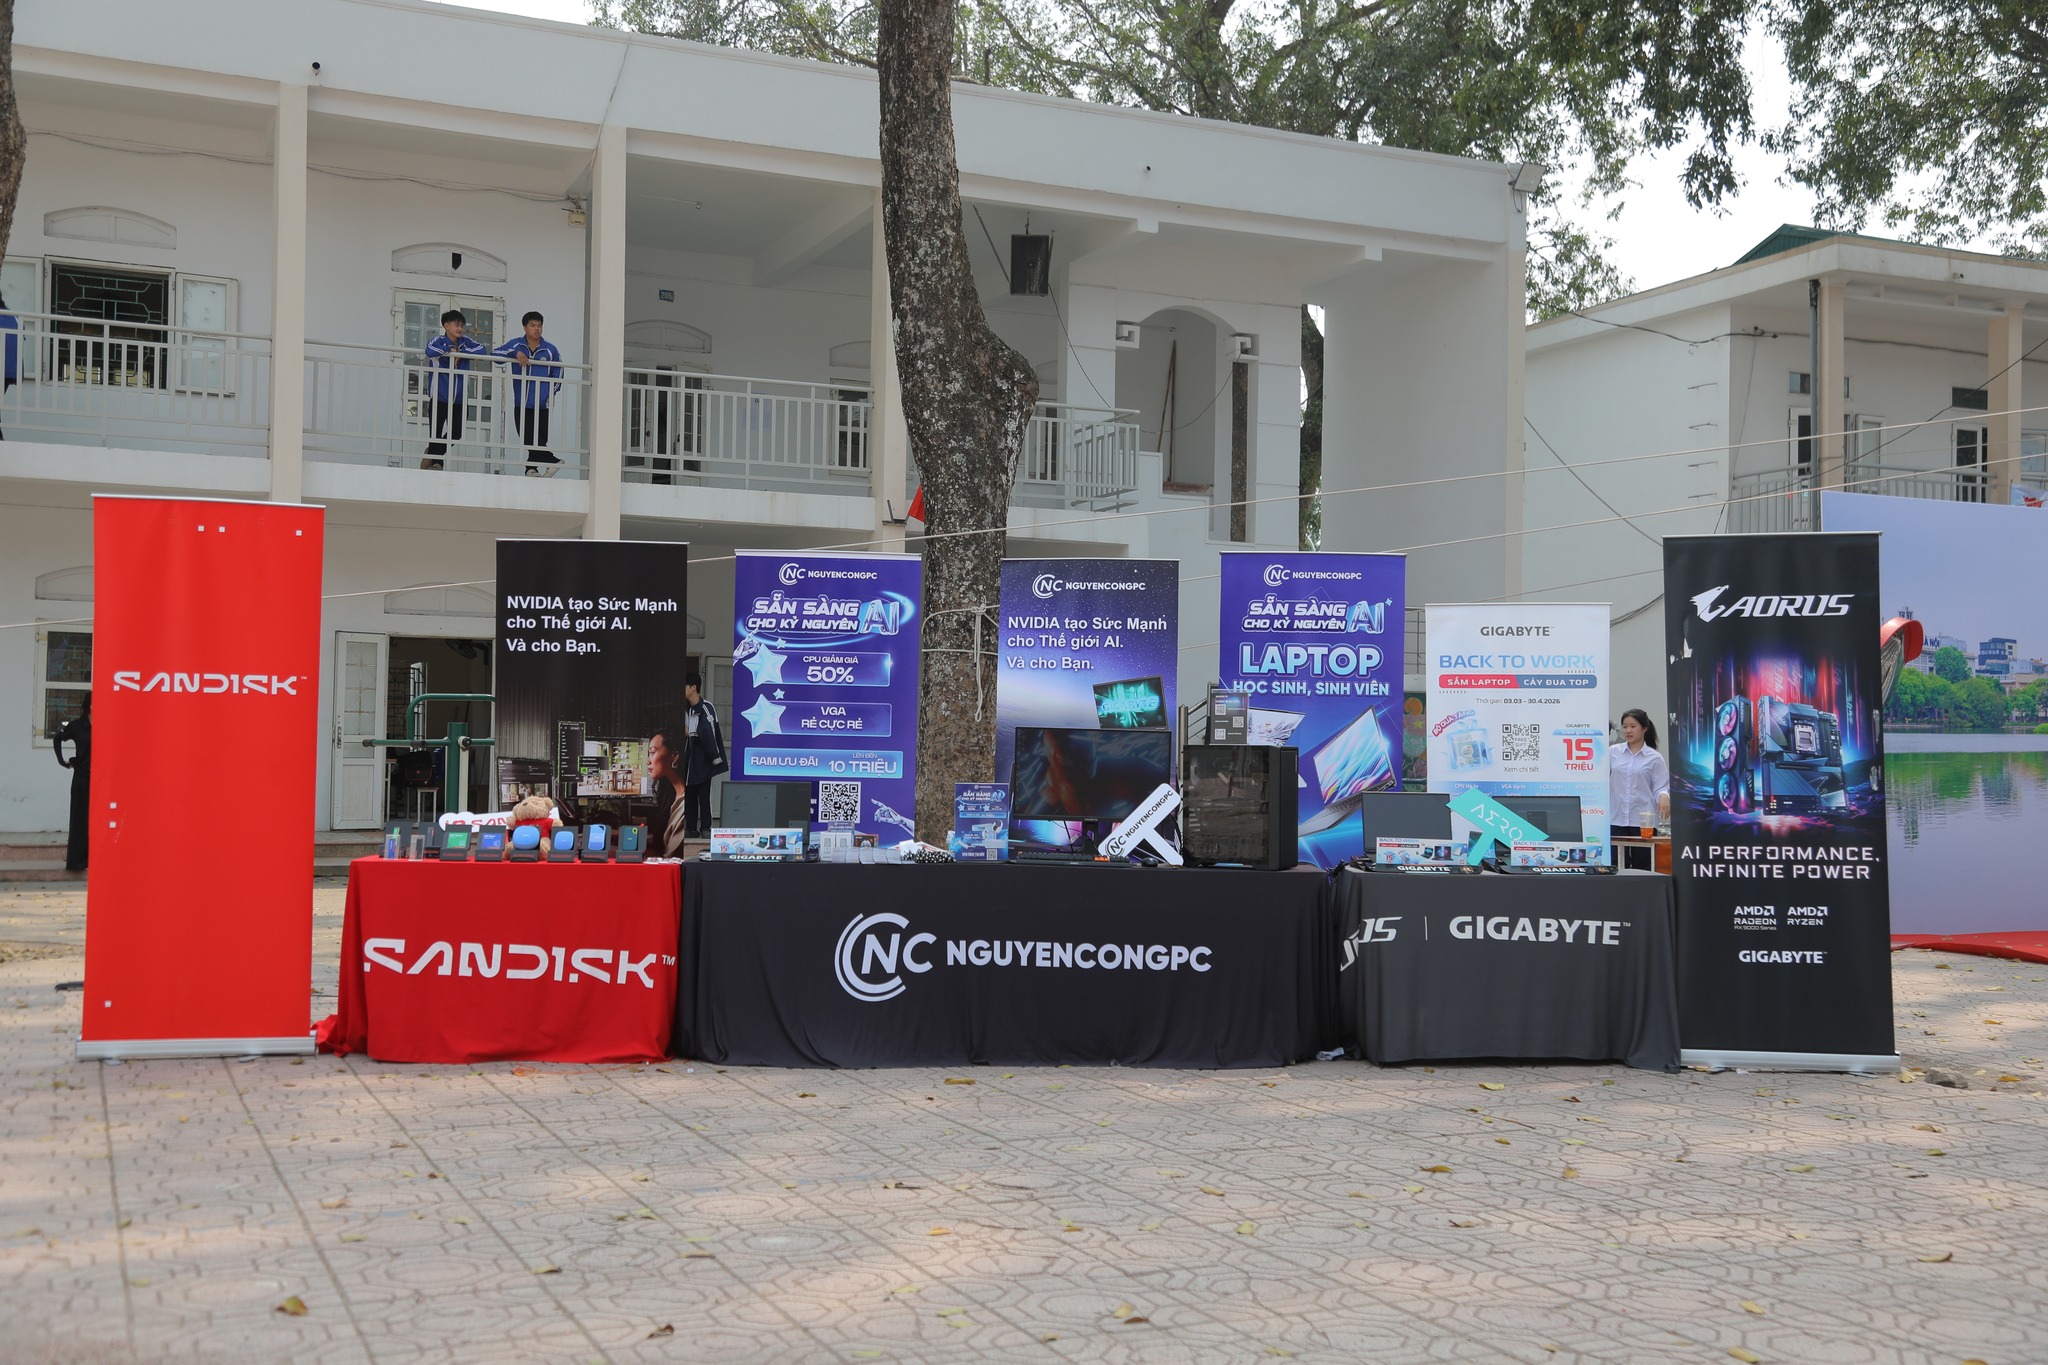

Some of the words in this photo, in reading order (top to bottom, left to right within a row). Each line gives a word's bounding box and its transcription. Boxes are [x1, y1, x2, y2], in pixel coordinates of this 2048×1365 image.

[808, 570, 878, 580] NGUYENCONGPC
[1292, 572, 1362, 580] NGUYENCONGPC
[1066, 582, 1146, 590] NGUYENCONGPC
[507, 596, 564, 609] NVIDIA
[568, 598, 593, 612] tạo
[598, 597, 630, 610] Sức
[635, 598, 677, 614] Mạnh
[754, 594, 797, 614] SẴN
[802, 598, 859, 616] SÀNG
[1250, 596, 1288, 615] SẴN
[1294, 600, 1347, 616] SÀNG
[1720, 594, 1855, 617] AORUS
[506, 616, 536, 629] cho
[541, 613, 570, 629] Thế
[576, 617, 606, 632] giới
[611, 618, 632, 630] AI.
[748, 618, 776, 628] CHO
[802, 618, 858, 630] NGUYÊN
[860, 600, 900, 636] AI
[1008, 617, 1060, 629] NVIDIA
[1065, 619, 1088, 631] tạo
[1092, 617, 1122, 629] Sức
[1127, 617, 1167, 632] Mạnh
[1244, 619, 1270, 629] CHO
[1294, 618, 1346, 630] NGUYÊN
[1348, 601, 1384, 634] AI
[1480, 626, 1550, 637] GIGABYTE
[506, 639, 526, 651] Và
[531, 639, 560, 652] cho
[566, 639, 600, 655] Bạn.
[1008, 635, 1034, 647] cho
[1039, 633, 1066, 647] Thế
[1071, 636, 1099, 650] giới
[1104, 636, 1124, 648] AI.
[822, 655, 844, 664] GIẢM
[844, 655, 858, 664] GIÁ
[1007, 656, 1025, 668] Và
[1030, 657, 1057, 669] cho
[1062, 657, 1094, 671] Bạn.
[1242, 646, 1380, 675] LAPTOP
[1439, 655, 1493, 669] BACK
[1498, 655, 1525, 668] TO
[1530, 655, 1595, 669] WORK
[806, 666, 854, 683] 50%
[1448, 676, 1468, 685] SẮM
[1524, 677, 1542, 685] CÀY
[113, 671, 297, 695] SANDISK
[1233, 681, 1268, 696] HỌC
[1272, 681, 1311, 696] SINH,
[1316, 682, 1350, 694] SINH
[1355, 680, 1389, 695] VIÊN
[821, 706, 846, 716] VGA
[801, 718, 817, 729] RẺ
[819, 719, 845, 732] CỰC
[847, 718, 863, 730] RẺ
[1563, 739, 1593, 760] 15
[751, 756, 777, 766] RAM
[778, 757, 797, 766] ƯU
[799, 756, 819, 766] ĐÃI
[828, 760, 846, 773] 10
[849, 758, 897, 776] TRIỆU
[1564, 762, 1593, 771] TRIỆU
[1125, 790, 1174, 838] NGUYENCONGPC
[1681, 846, 1700, 859] AI
[1709, 846, 1880, 862] PERFORMANCE,
[1693, 864, 1784, 878] INFINITE
[1793, 865, 1870, 879] POWER
[1734, 906, 1763, 916] AMD
[1787, 906, 1816, 916] AMD
[1449, 916, 1621, 945] GIGABYTE
[364, 938, 656, 988] SANDISK
[946, 940, 1212, 972] NGUYENCONGPC
[1738, 950, 1823, 963] GIGABYTE
